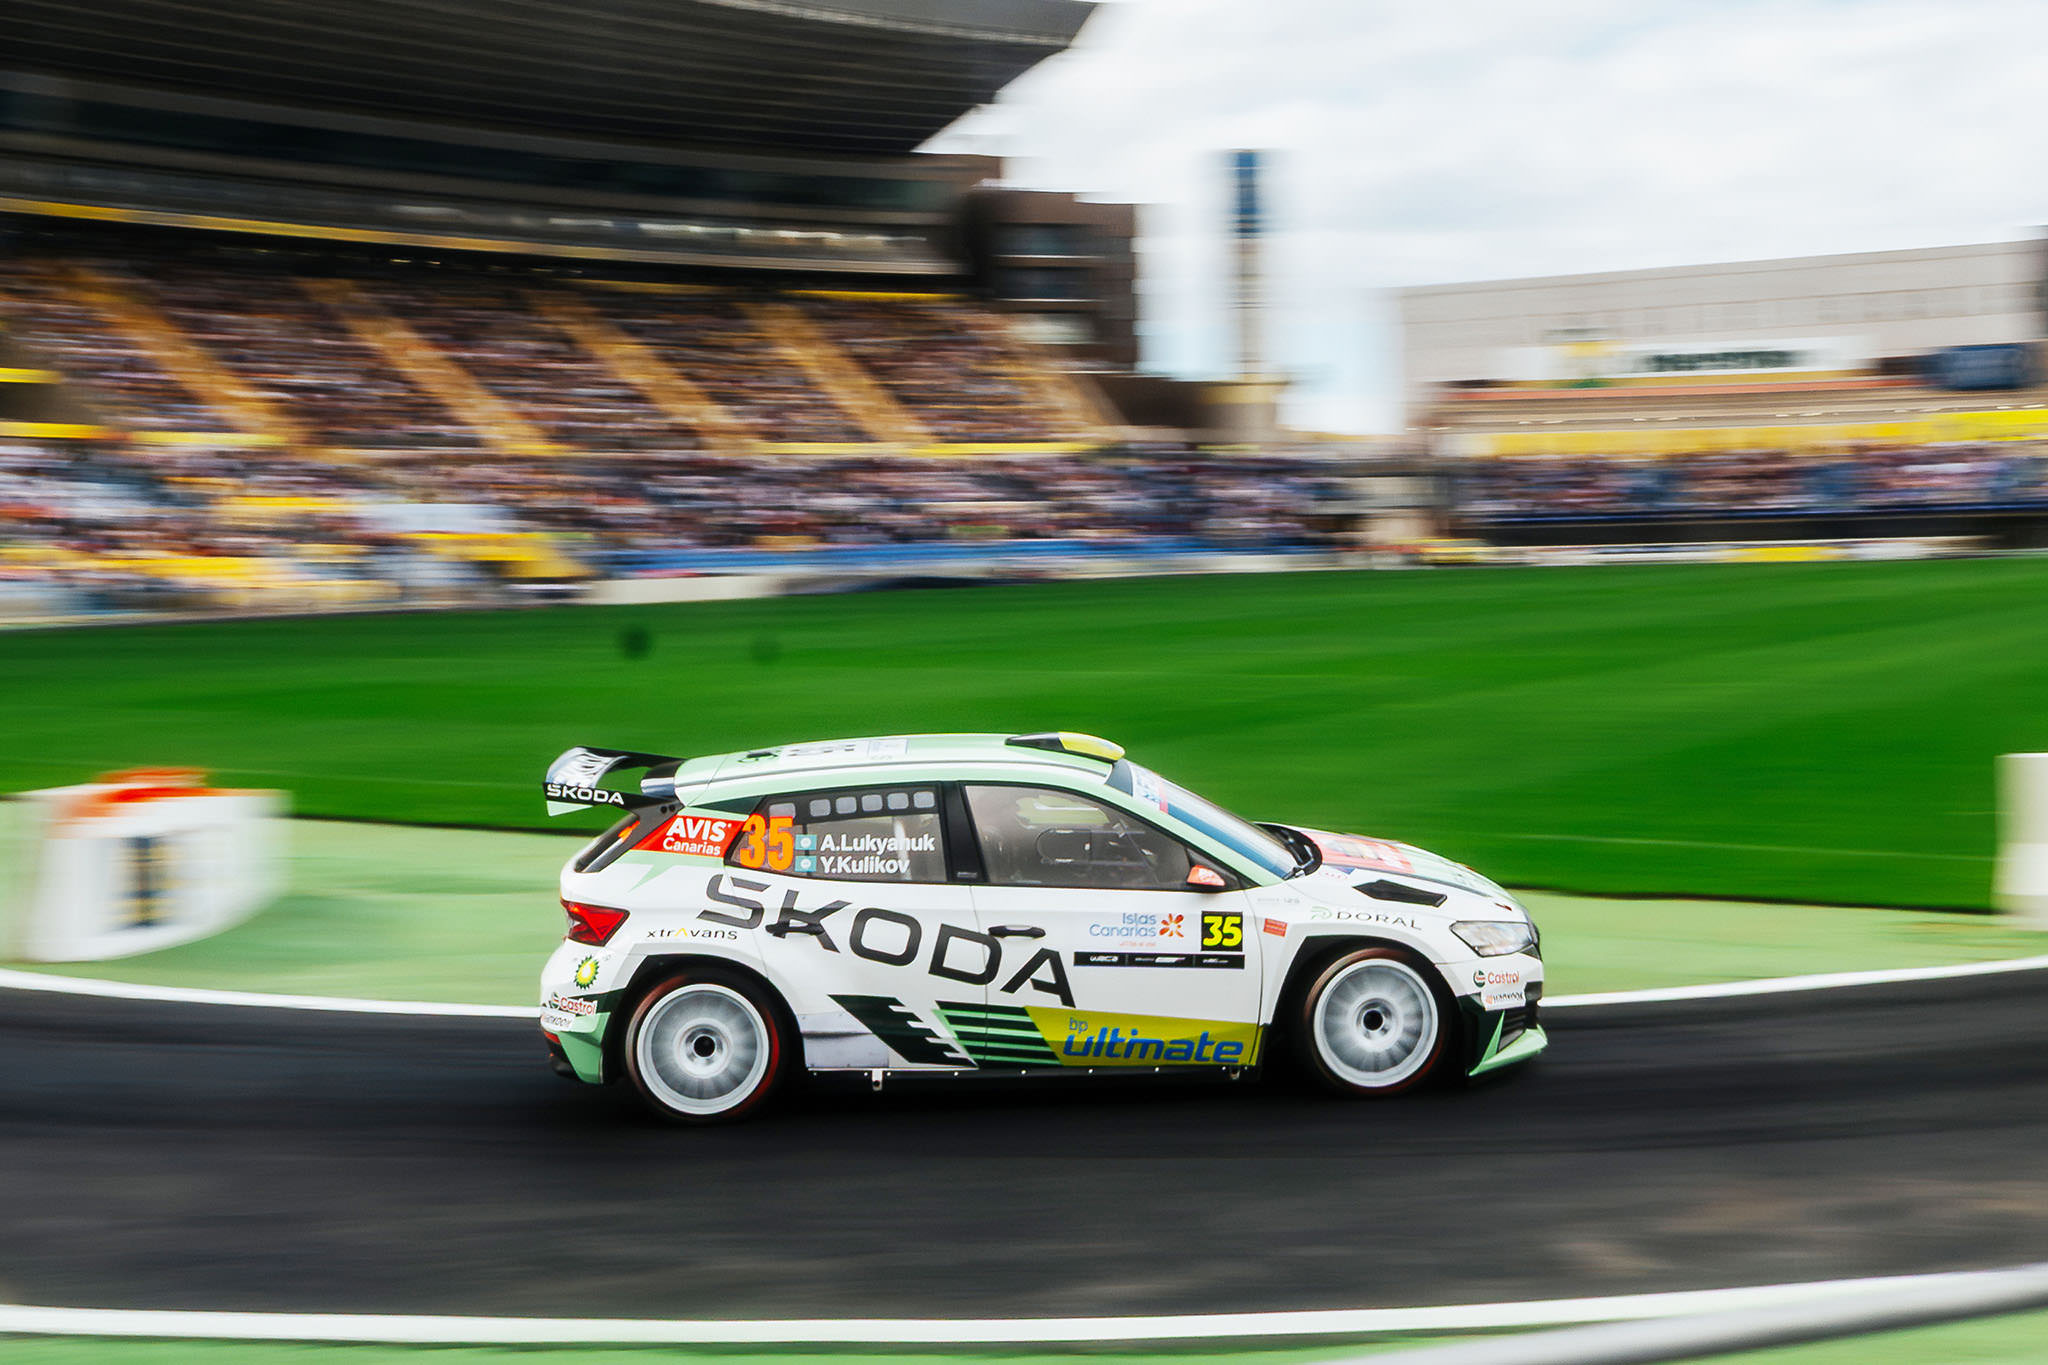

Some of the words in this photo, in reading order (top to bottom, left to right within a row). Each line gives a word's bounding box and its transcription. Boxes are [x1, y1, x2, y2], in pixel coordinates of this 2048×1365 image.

[666, 817, 727, 842] AVIS
[662, 837, 721, 856] Canarias
[739, 812, 794, 871] 35
[820, 856, 911, 874] Y.Kulikov
[1122, 912, 1156, 925] Islas
[1337, 911, 1422, 931] DORAL
[1089, 923, 1157, 937] Canarias
[1202, 915, 1243, 947] 35
[1487, 970, 1520, 985] Castrol
[560, 996, 596, 1015] Castrol
[1069, 1016, 1089, 1034] bp
[1063, 1026, 1244, 1064] ultimate
